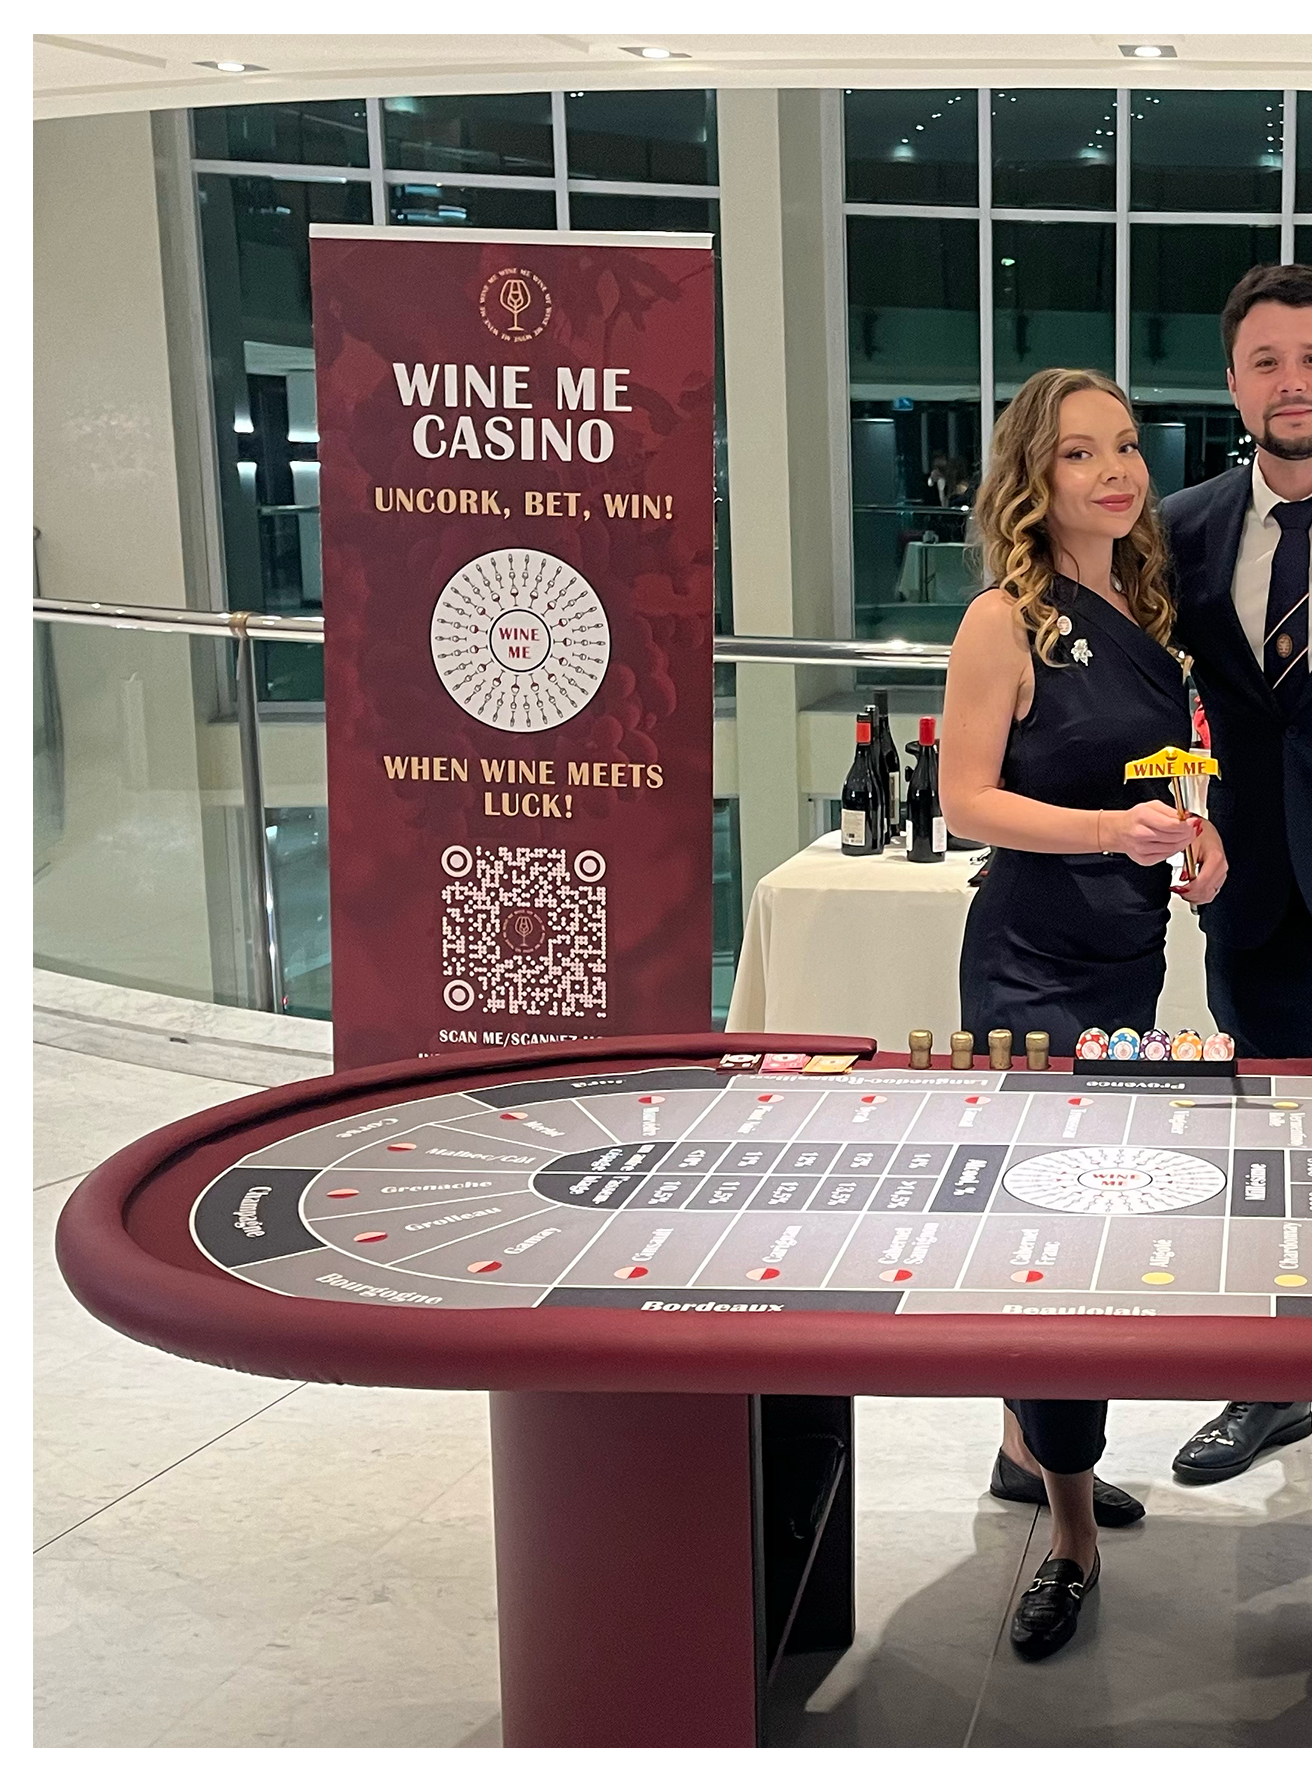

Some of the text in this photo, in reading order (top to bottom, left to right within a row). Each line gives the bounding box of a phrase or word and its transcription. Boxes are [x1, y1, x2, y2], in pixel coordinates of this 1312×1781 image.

[392, 363, 633, 412] WINE ME
[413, 414, 615, 463] CASINO
[375, 487, 674, 521] UNCORK, BET, WIN!
[499, 627, 540, 642] WINE
[508, 645, 531, 659] ME
[383, 755, 664, 789] WHEN WINE MEETS
[1133, 761, 1207, 777] WINE ME
[484, 792, 573, 819] LUCK!
[439, 1030, 477, 1044] SCAN
[1086, 1081, 1185, 1090] Provence
[335, 1117, 399, 1140] Corse
[380, 1179, 492, 1194] Grenache
[233, 1186, 273, 1239] Champagne
[404, 1207, 502, 1232] Grolleau
[504, 1227, 562, 1255] Gamay
[1035, 1241, 1061, 1266] Franc
[315, 1273, 443, 1306] Bourgogne
[640, 1300, 785, 1313] Bordeaux
[1002, 1304, 1157, 1316] Beaujolais
